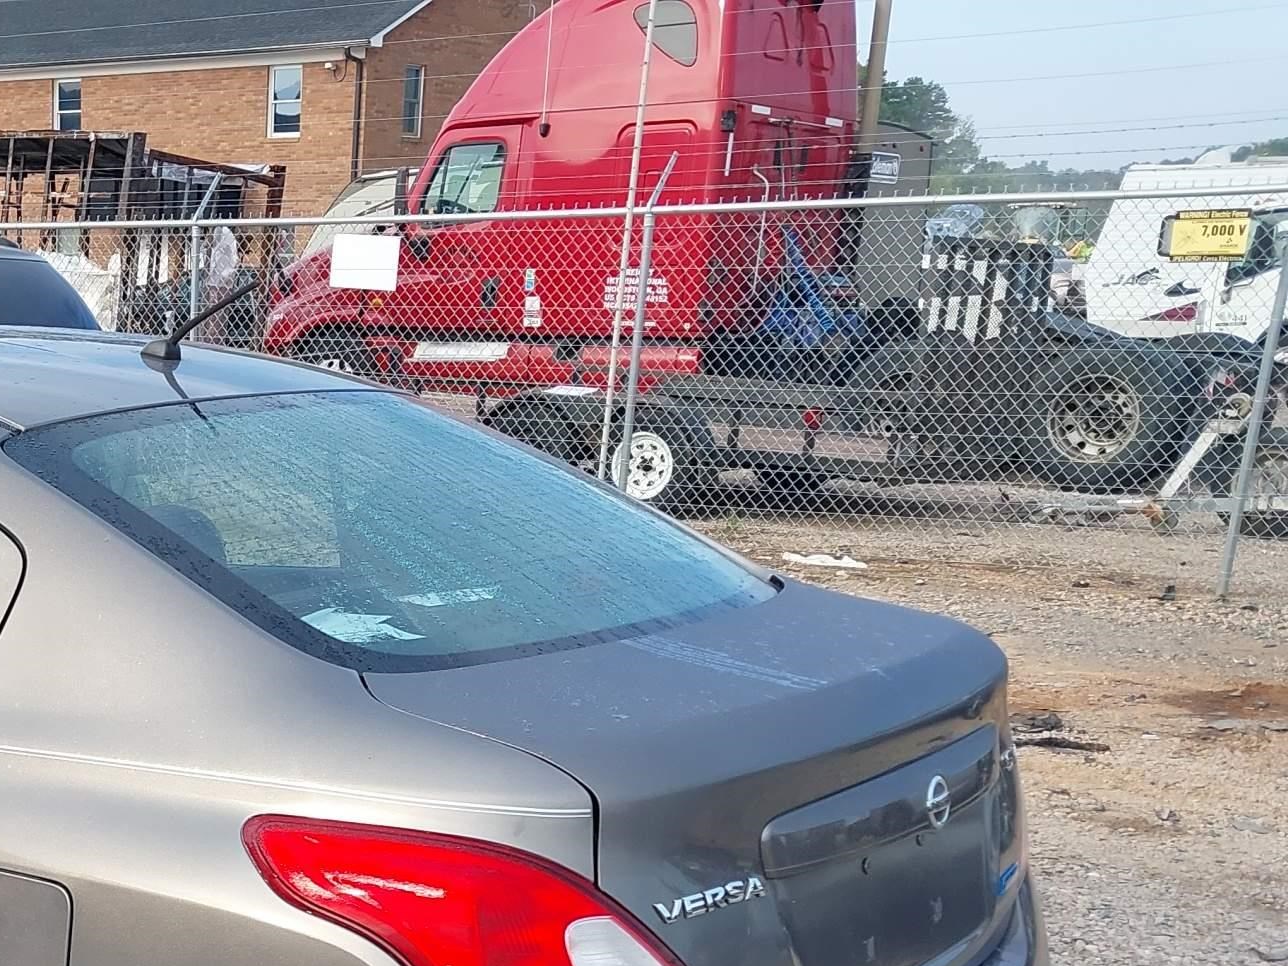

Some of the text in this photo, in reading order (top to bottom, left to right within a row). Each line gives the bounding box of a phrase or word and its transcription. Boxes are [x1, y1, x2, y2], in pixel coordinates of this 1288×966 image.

[1201, 224, 1247, 238] 7,000 V
[653, 875, 767, 924] VERSA
